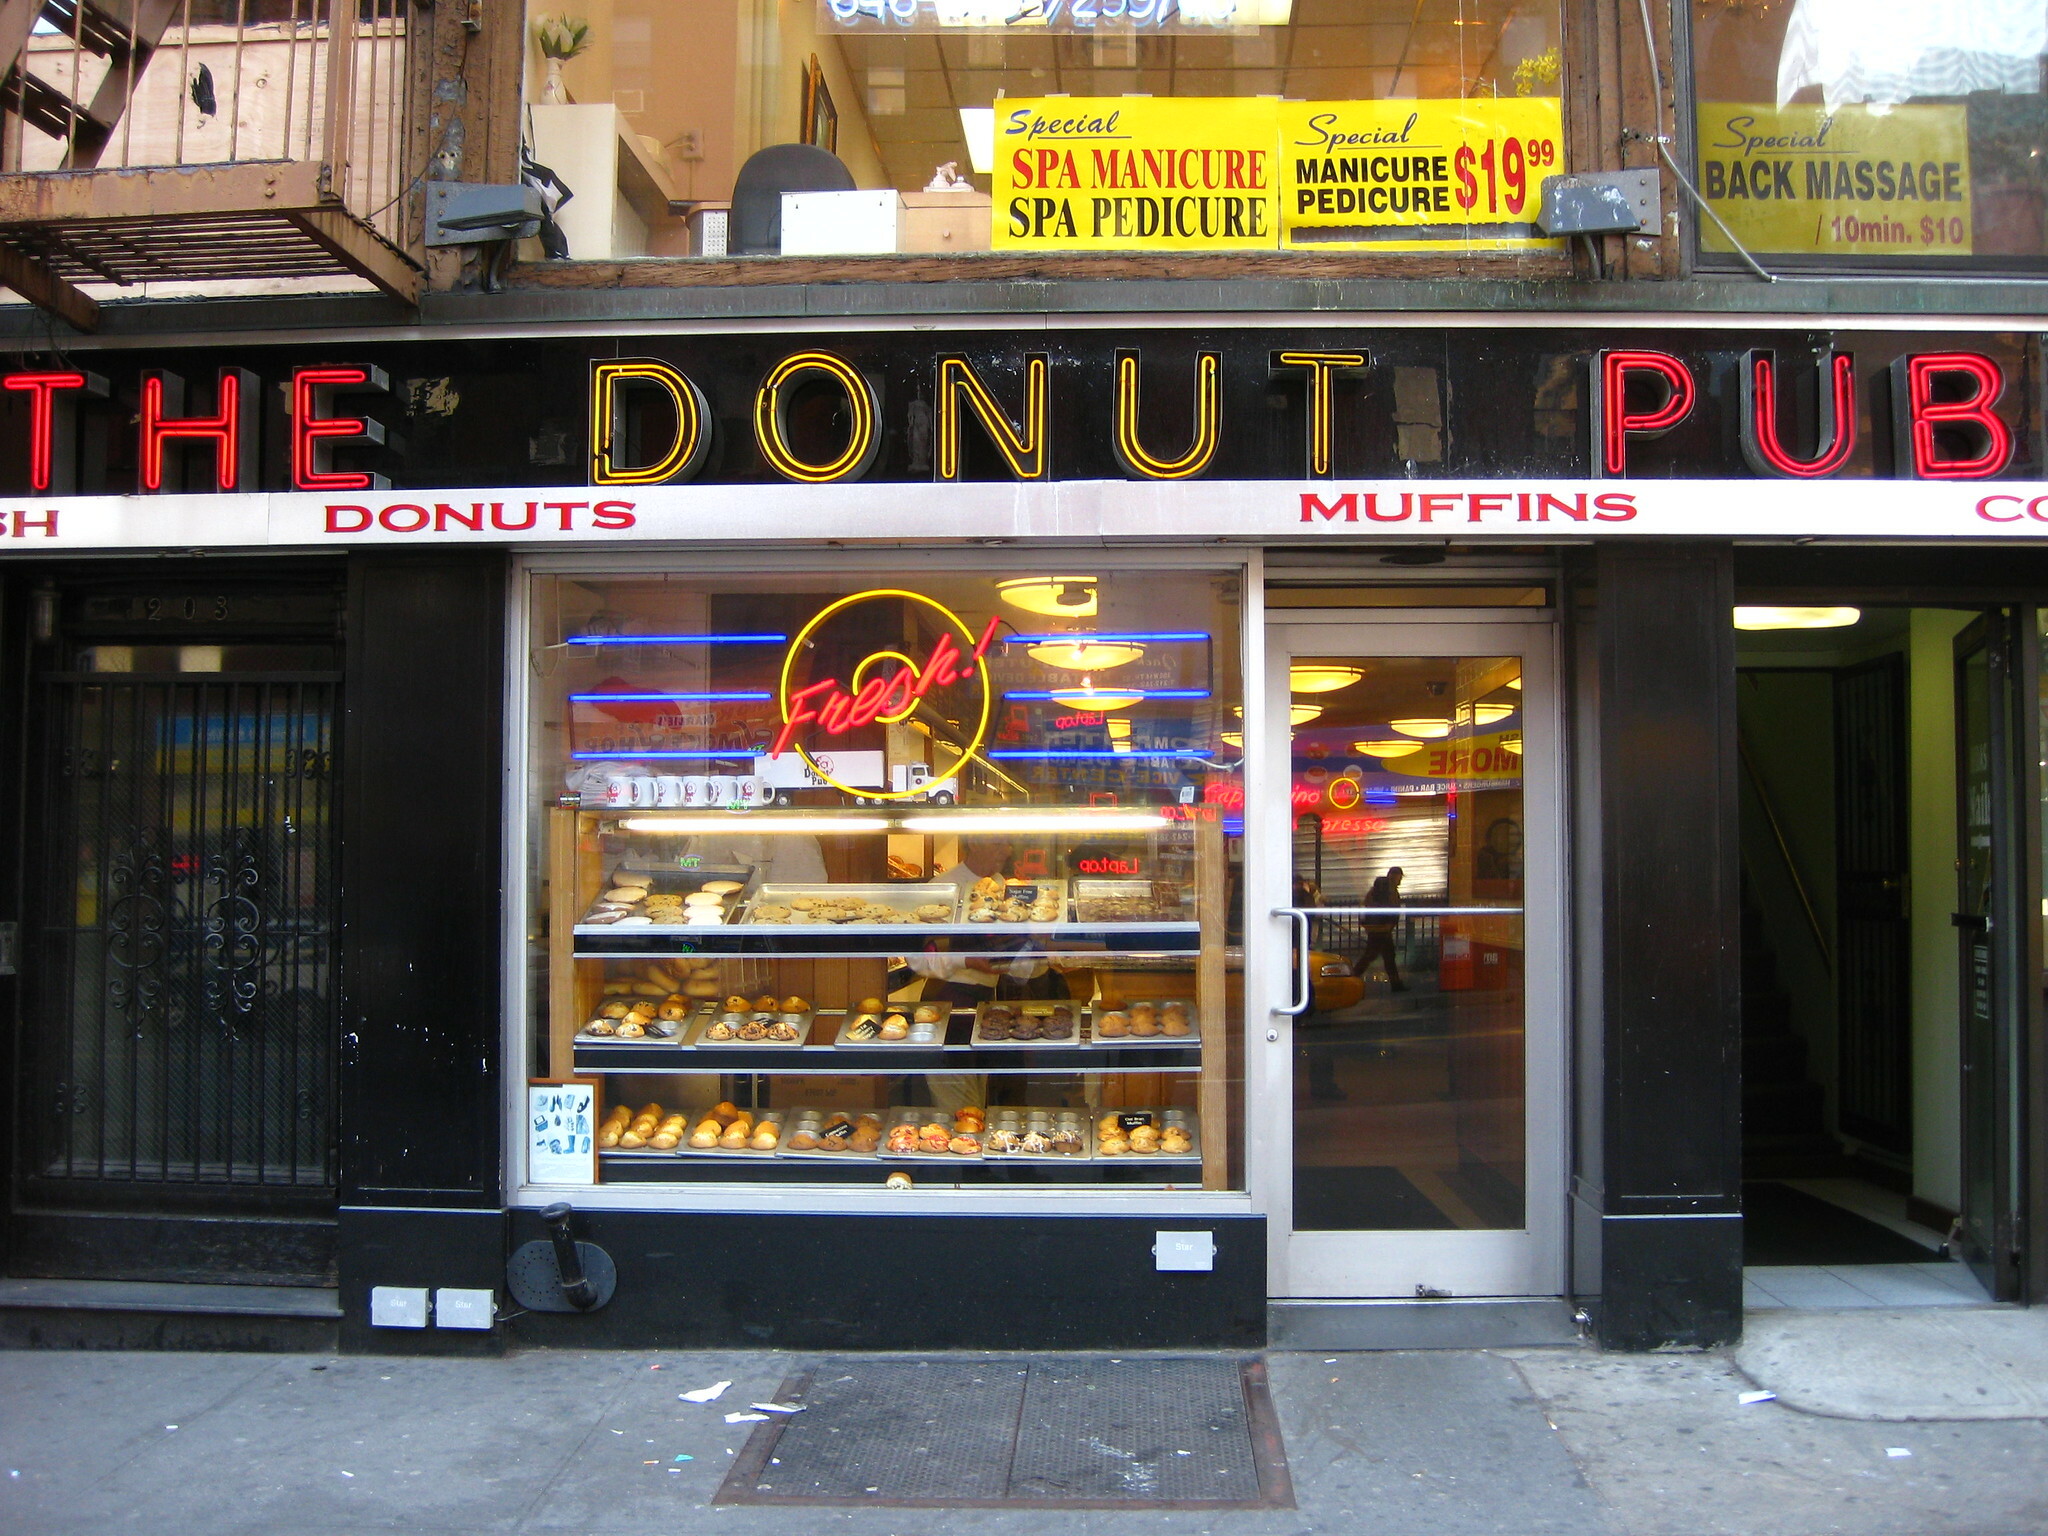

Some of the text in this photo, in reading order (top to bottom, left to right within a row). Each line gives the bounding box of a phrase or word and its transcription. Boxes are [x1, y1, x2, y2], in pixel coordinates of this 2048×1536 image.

[1005, 109, 1119, 141] Special
[1294, 113, 1417, 154] Special
[1712, 116, 1833, 156] Special
[1012, 148, 1267, 190] SPA MANICURE
[1296, 156, 1448, 184] MANICURE
[1705, 160, 1962, 201] BACK MASSAGE
[1009, 197, 1078, 238] SPA
[1090, 197, 1268, 238] PEDICURE
[1297, 186, 1450, 215] PEDICURE
[1831, 215, 1913, 243] 10min.
[1919, 214, 1964, 247] $10
[3, 348, 2012, 491] THE DONUT PUB
[0, 509, 59, 537] H
[324, 500, 637, 534] DONUTS
[1299, 493, 1639, 523] MUFFINS
[146, 595, 229, 621] 203
[772, 615, 1001, 760] Fresh!
[1175, 1242, 1194, 1252] Star
[455, 1300, 472, 1309] Star
